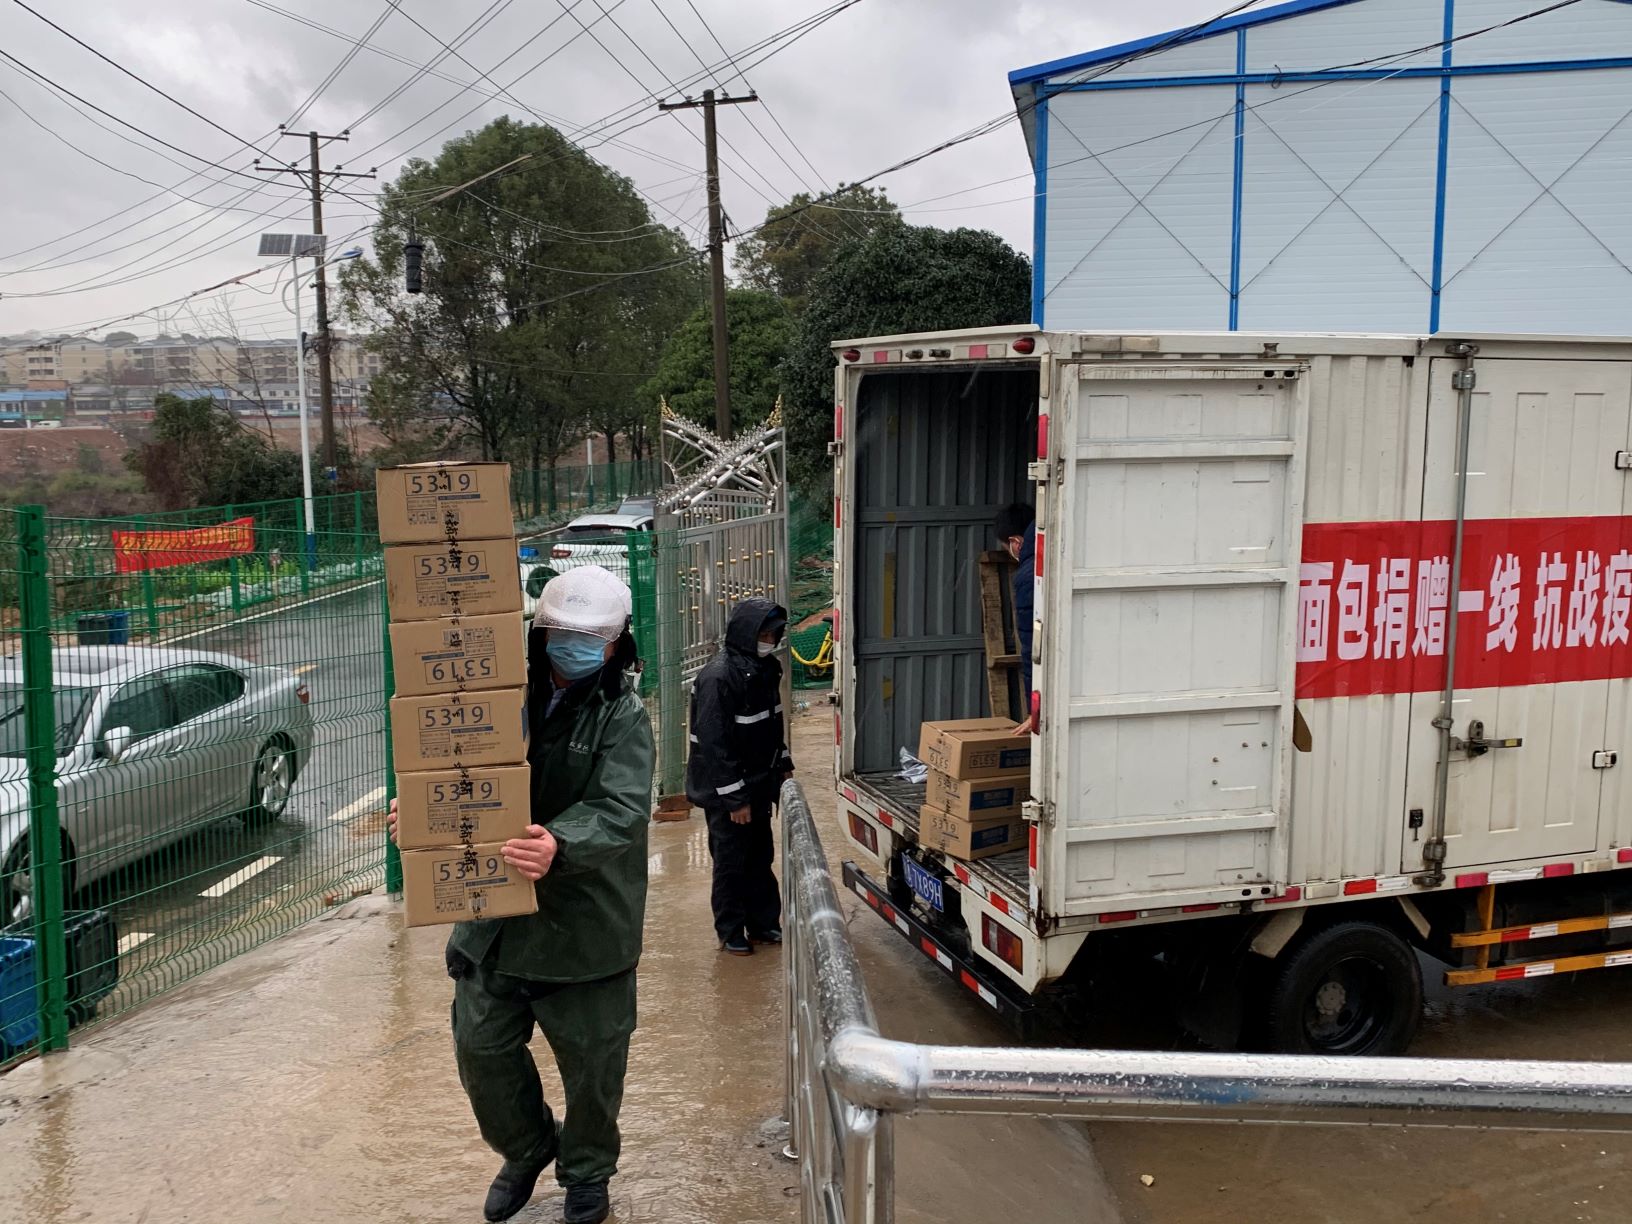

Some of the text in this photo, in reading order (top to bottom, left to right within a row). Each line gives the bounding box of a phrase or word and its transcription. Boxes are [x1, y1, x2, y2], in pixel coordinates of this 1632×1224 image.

[411, 473, 471, 494] 5319
[1296, 549, 1632, 662] 面包捐赠一线 抗战疫
[432, 657, 492, 681] 5319
[424, 705, 484, 728] 5319
[439, 857, 498, 882] 5319
